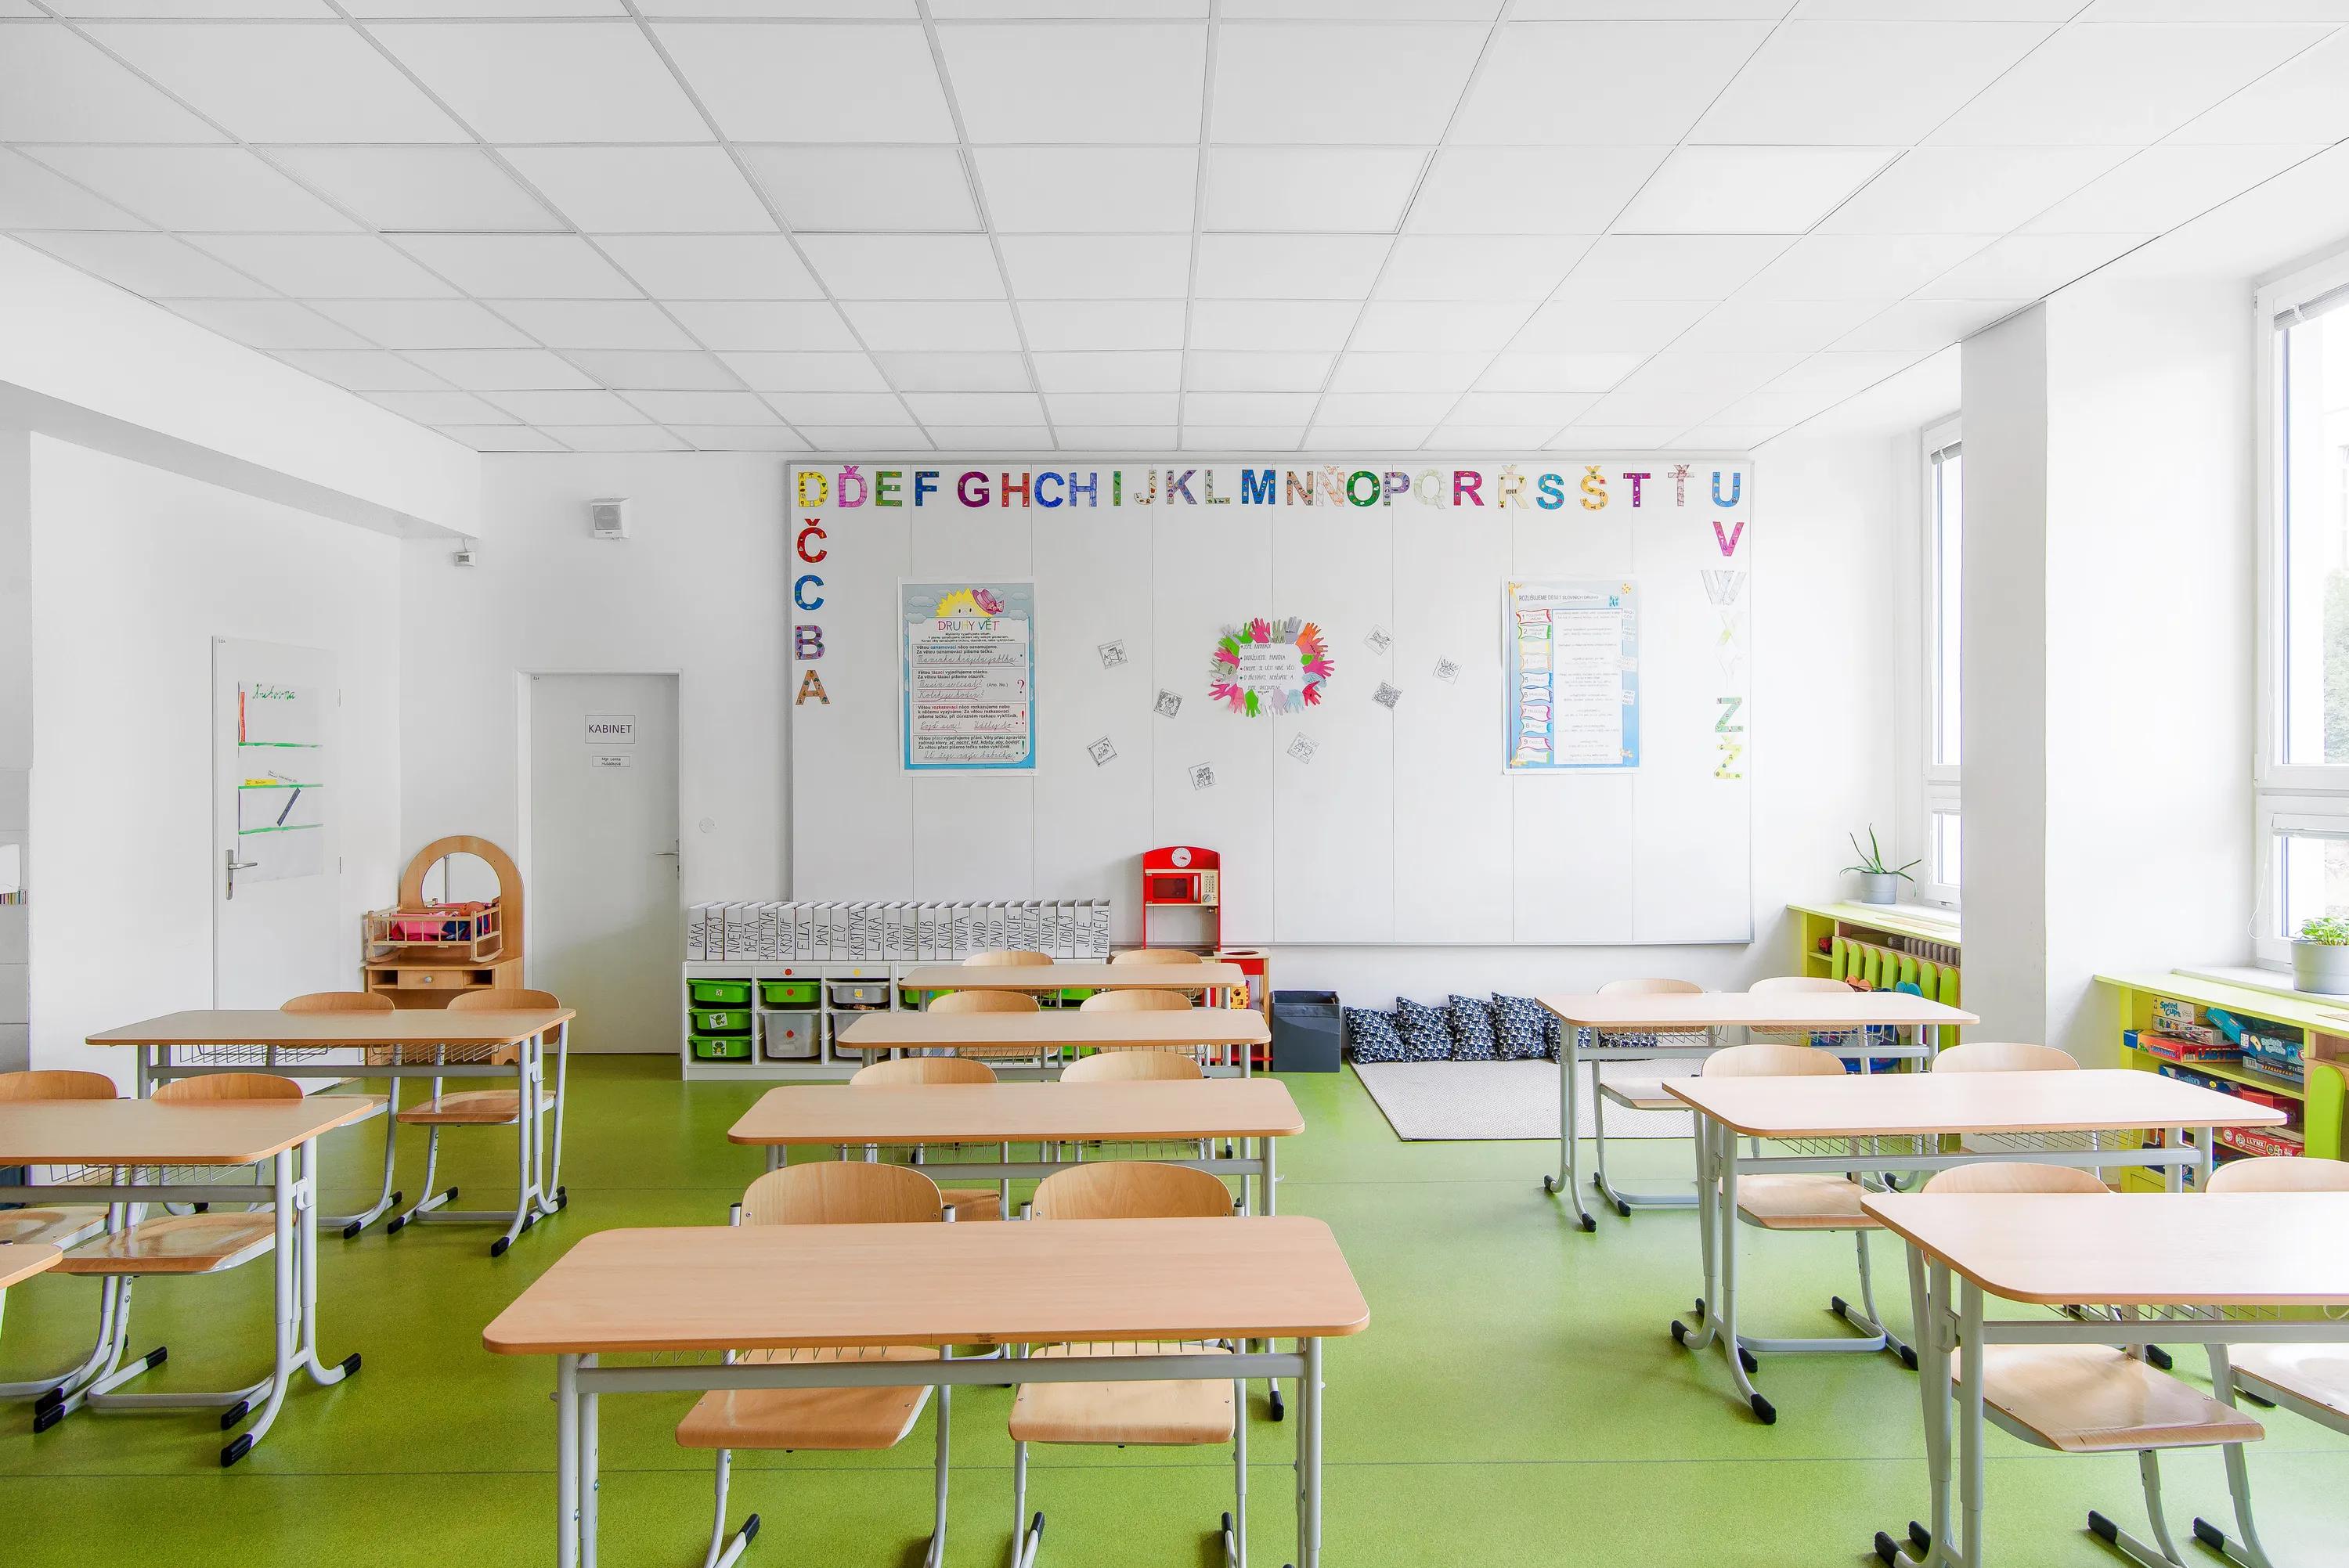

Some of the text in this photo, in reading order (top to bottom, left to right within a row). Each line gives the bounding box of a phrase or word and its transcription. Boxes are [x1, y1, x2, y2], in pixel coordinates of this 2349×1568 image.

[798, 471, 828, 507] D
[839, 465, 868, 507] Ď
[875, 470, 902, 507] E
[915, 471, 940, 506] F
[958, 471, 990, 508] G
[1001, 472, 1030, 507] H
[1113, 470, 1122, 506] I
[1134, 470, 1156, 505] J
[1166, 470, 1197, 505] K
[1204, 470, 1231, 505] L
[1242, 470, 1276, 505] M
[1286, 471, 1313, 506] N
[1316, 463, 1344, 507] Ň
[1346, 471, 1380, 507] O
[1384, 471, 1410, 506] P
[1414, 471, 1445, 510] Q
[1454, 471, 1485, 506] R
[1498, 464, 1530, 510] Ř
[1535, 474, 1564, 510] S
[1580, 465, 1609, 510] Š
[1622, 473, 1651, 508] T
[1667, 463, 1694, 507] Ť
[1712, 471, 1741, 507] U
[797, 518, 828, 564] Č
[1712, 521, 1745, 557] V
[794, 575, 824, 611] C
[1701, 570, 1747, 606] W
[938, 617, 1000, 631] DRUHY VĚT
[1716, 611, 1746, 648] X
[795, 625, 825, 660] B
[795, 669, 831, 705] A
[589, 724, 632, 733] KABINET
[1715, 697, 1744, 733] Z
[1713, 734, 1743, 779] Ž
[689, 922, 704, 947] BÁRA
[706, 917, 723, 953] MATYÁŠ
[727, 921, 742, 953] NOEMI
[742, 921, 758, 952] BEÁTA
[759, 912, 775, 957] KRISTÝNA
[778, 917, 792, 954] KRYŠTOF
[797, 921, 810, 950] ELLA
[815, 925, 828, 946] DAN
[832, 925, 846, 952] TEO
[849, 910, 864, 956] KRISTÝNA
[868, 917, 882, 951] LAURA
[886, 922, 899, 950] ADAM
[903, 922, 916, 952] NIKOL
[919, 921, 933, 950] JAKUB
[954, 916, 969, 951] DOROTA
[972, 922, 986, 947] DAVID
[990, 921, 1003, 947] DAVID
[1040, 916, 1055, 949] JINDRA
[1058, 915, 1073, 950] TOBIÁŠ
[1076, 921, 1092, 947] JULIE
[1093, 910, 1109, 953] MICHAELA
[2160, 1001, 2178, 1011] Speed
[2165, 1008, 2181, 1018] Cups
